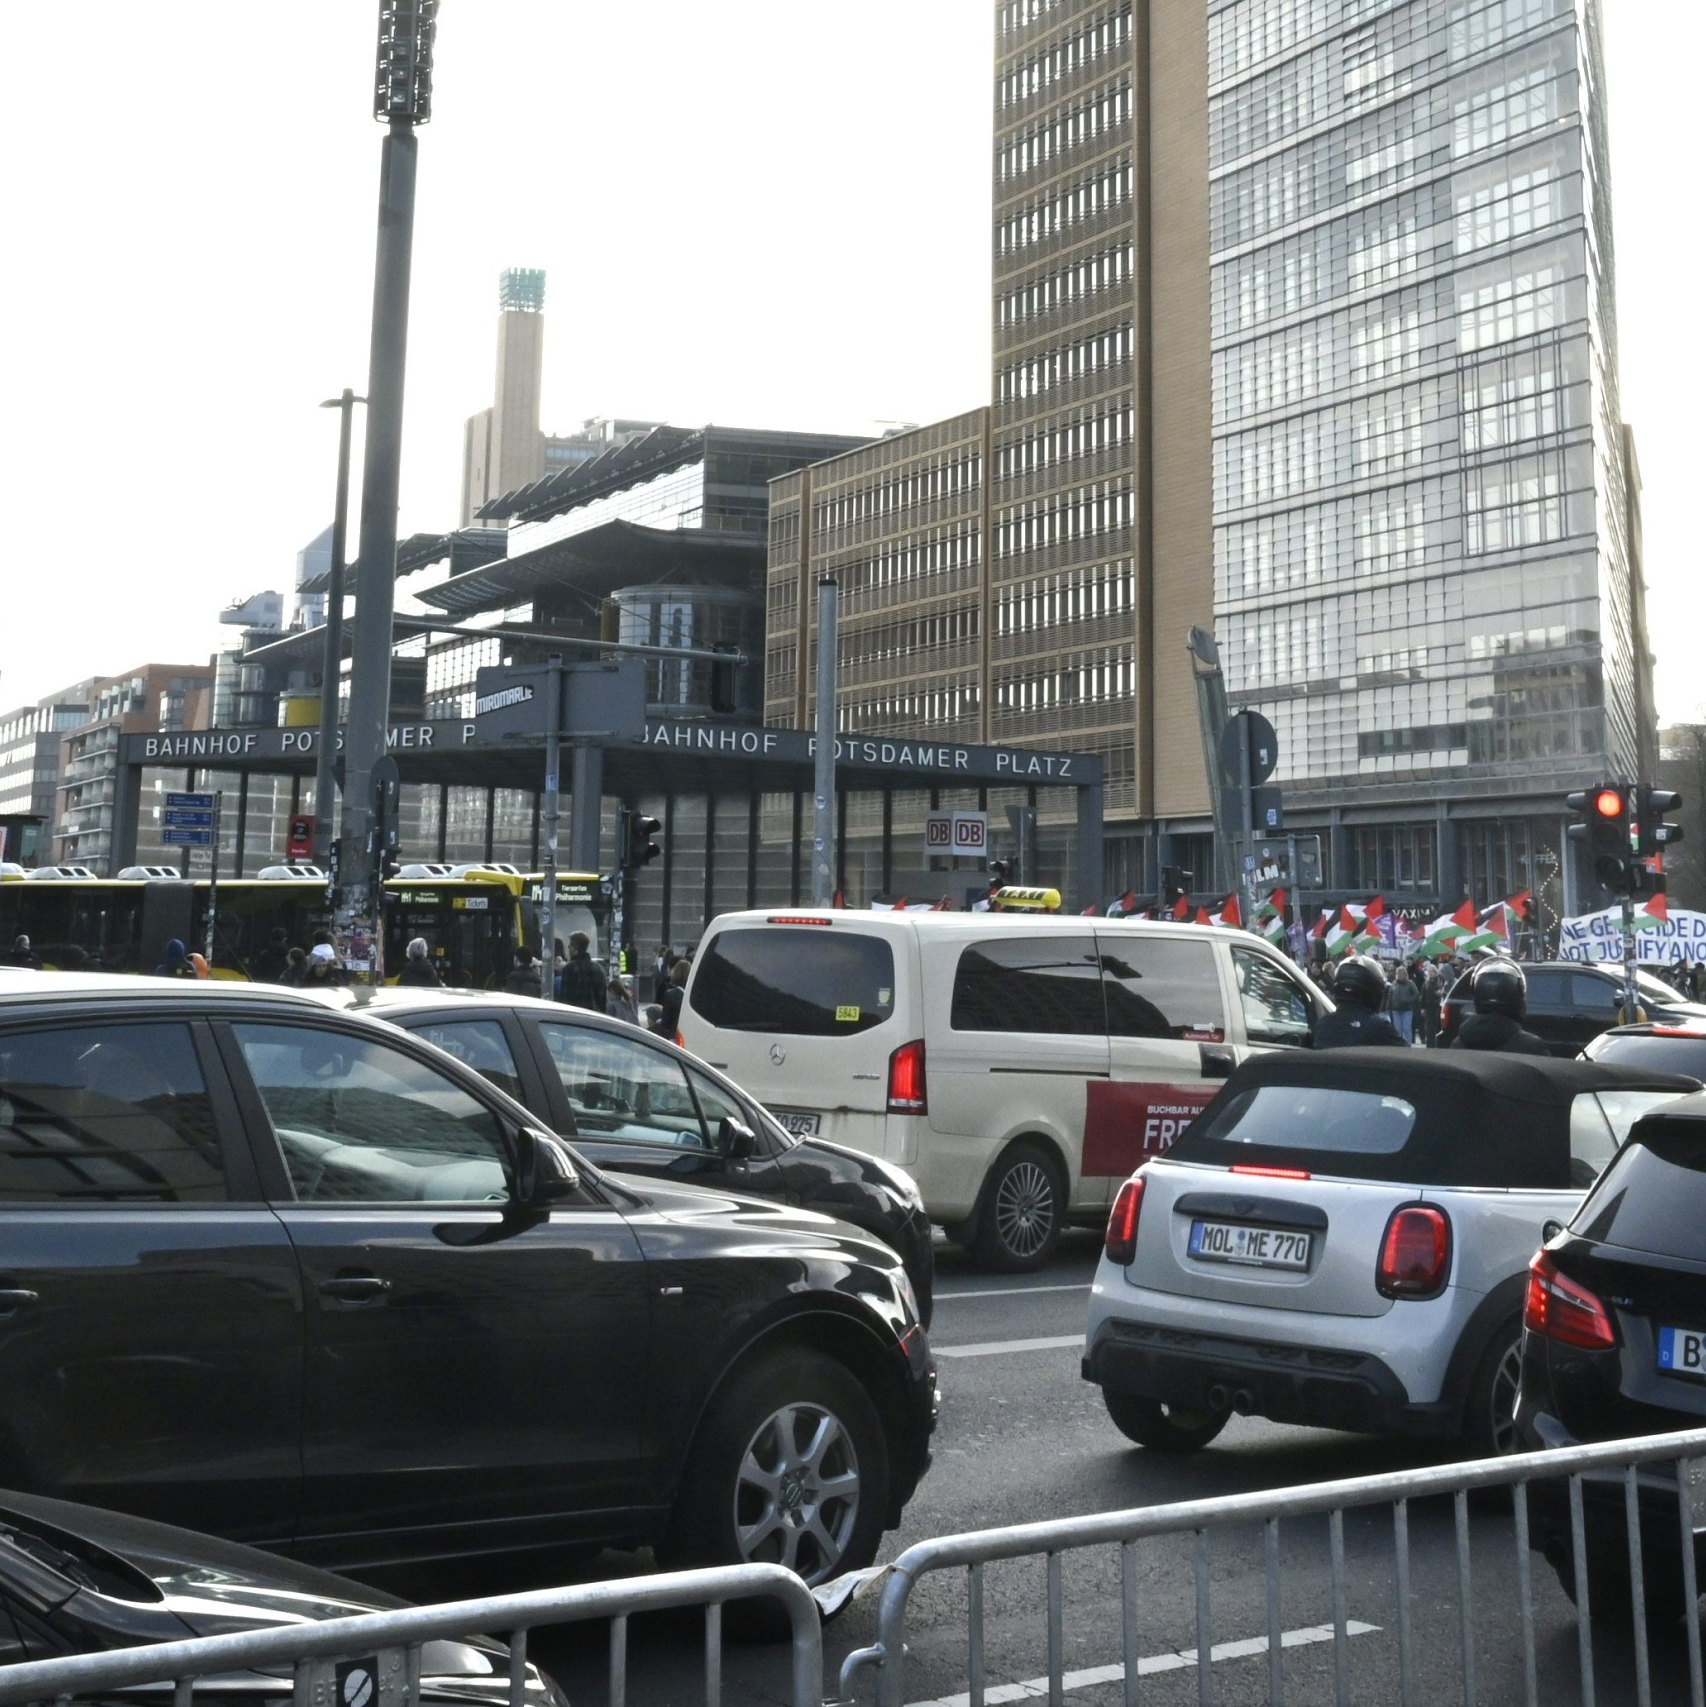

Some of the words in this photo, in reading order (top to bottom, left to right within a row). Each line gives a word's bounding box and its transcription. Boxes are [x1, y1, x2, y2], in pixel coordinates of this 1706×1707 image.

[145, 734, 258, 757] BAHNHOF
[281, 725, 434, 752] POSMER
[995, 753, 1072, 777] PLATZ
[930, 823, 949, 842] DB
[958, 823, 982, 842] DB
[1002, 890, 1044, 900] TAXI
[1597, 937, 1666, 961] JUSIFY
[838, 1007, 857, 1019] 5843
[1147, 1105, 1189, 1114] BUCHBAR
[790, 1116, 814, 1133] 975
[1201, 1226, 1234, 1254] MOL
[1246, 1231, 1270, 1257] ME
[1272, 1234, 1307, 1261] 770
[1683, 1335, 1700, 1368] B
